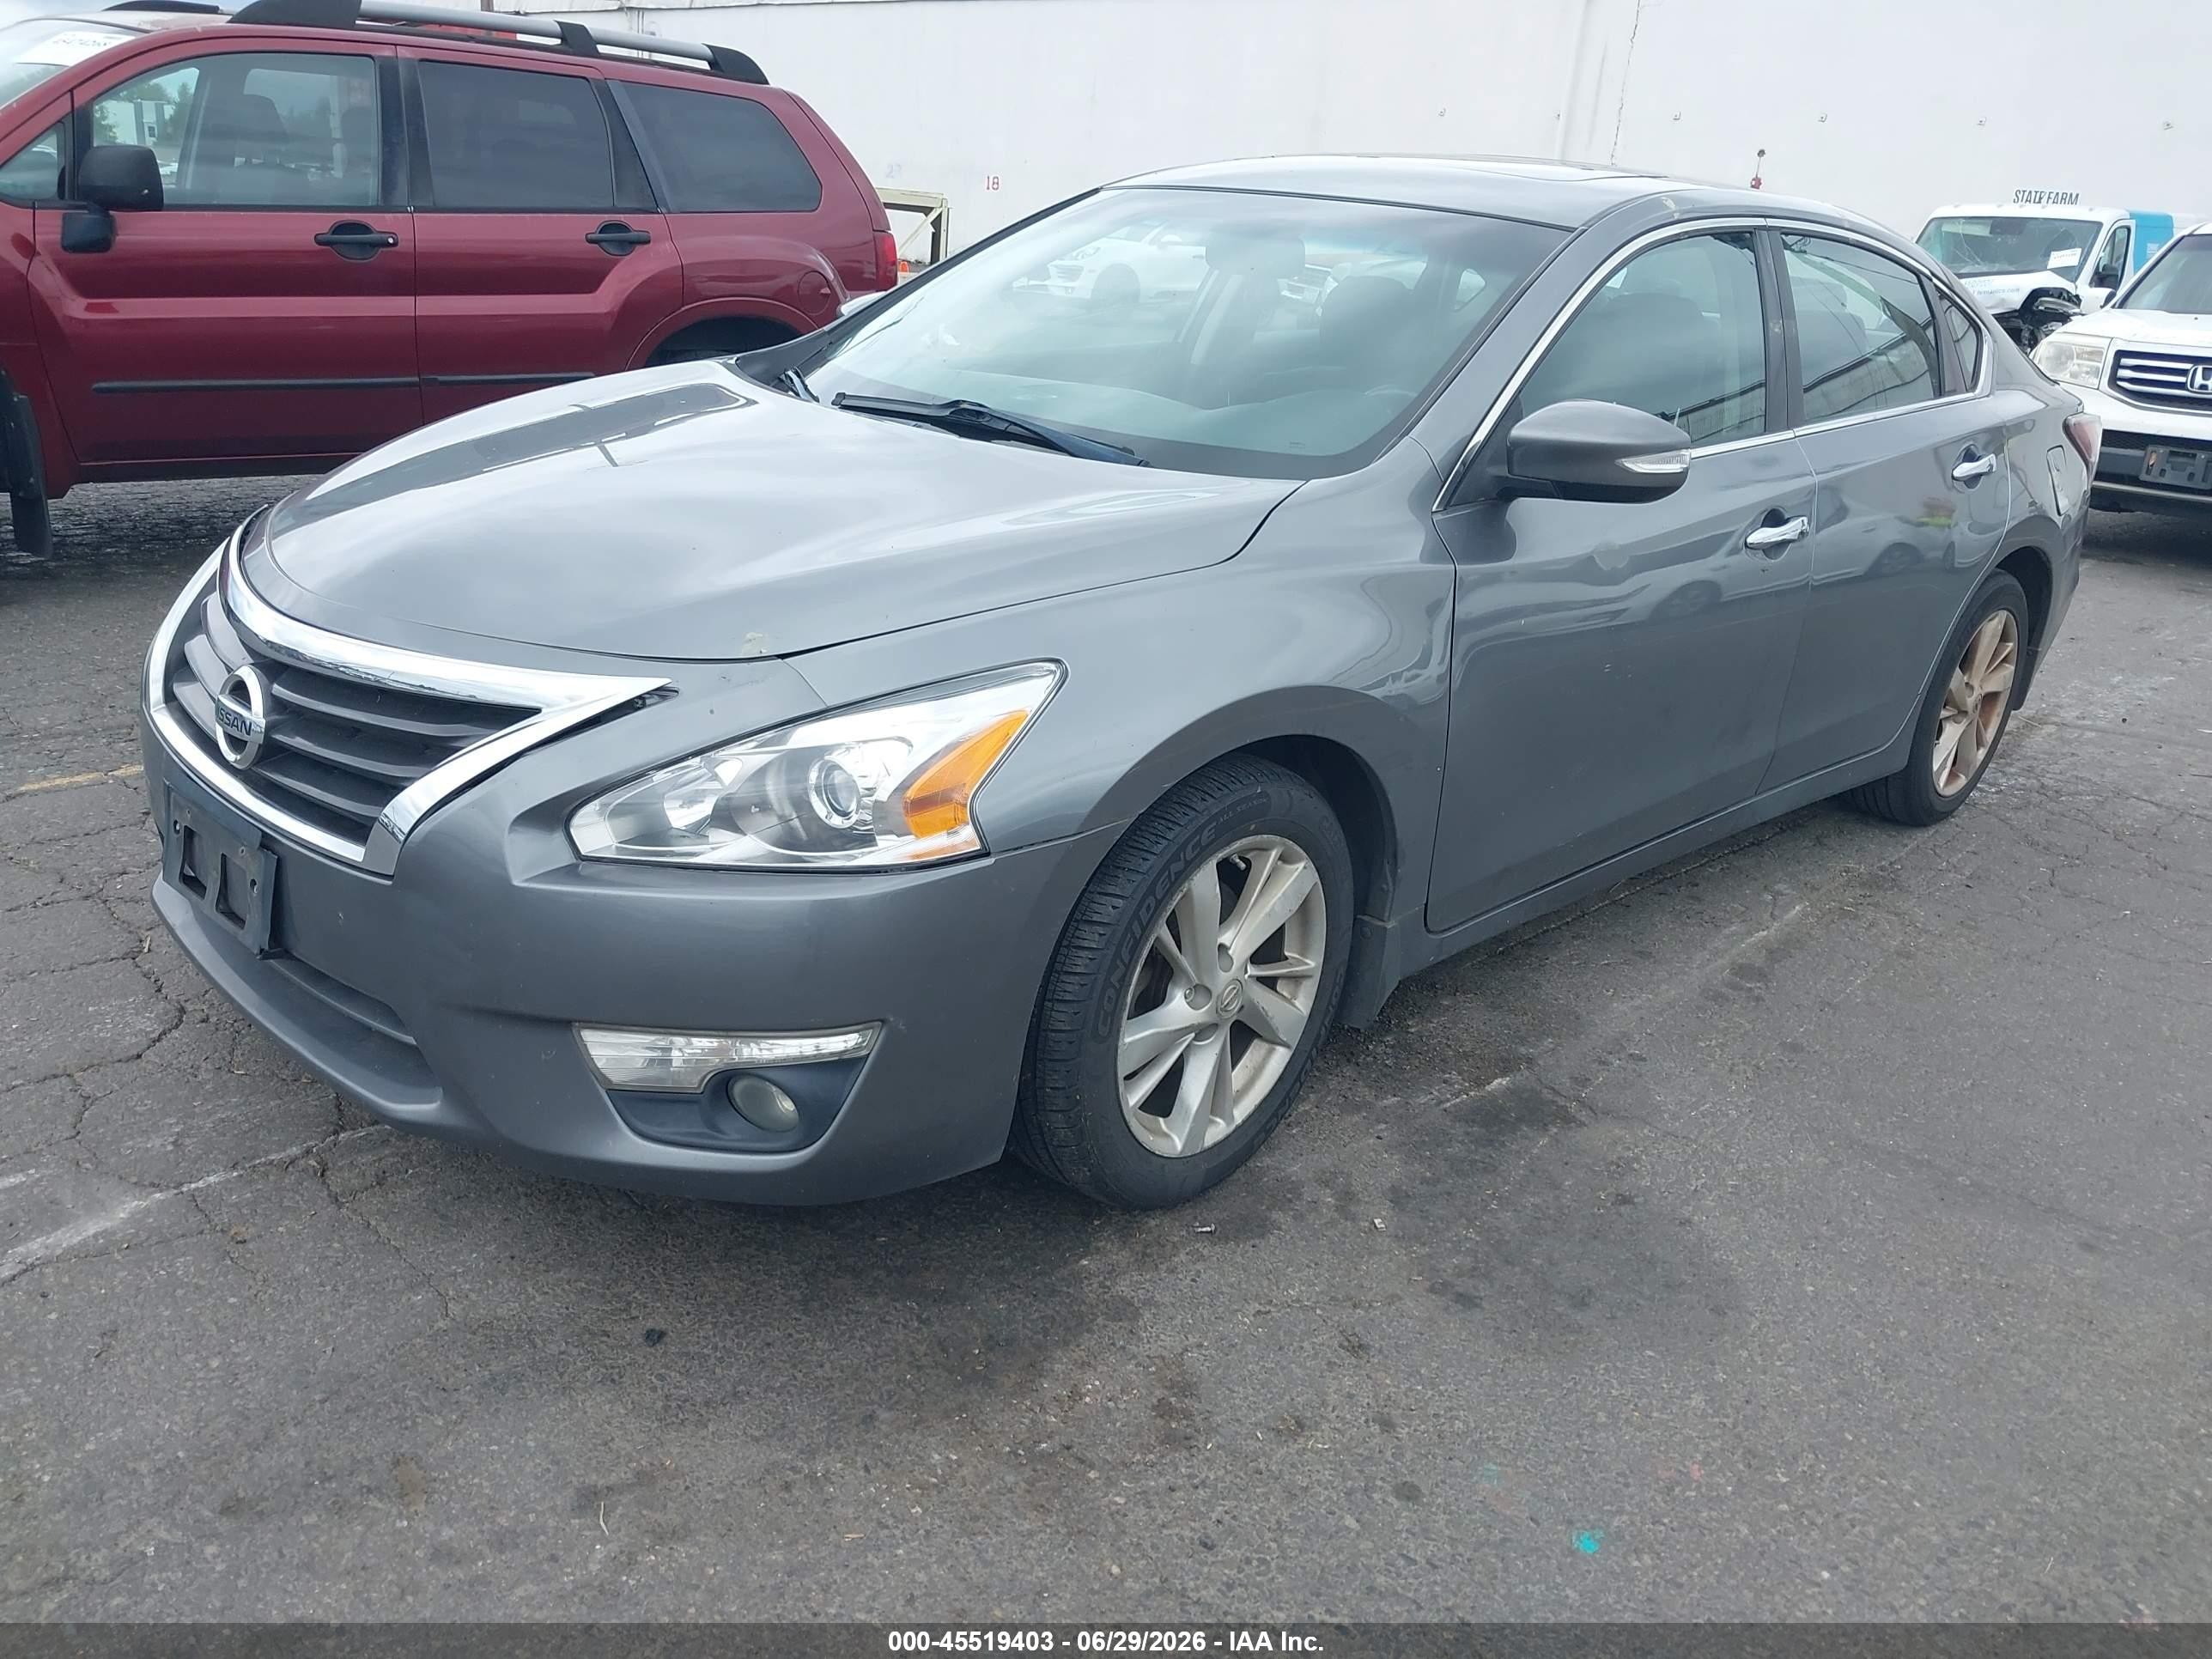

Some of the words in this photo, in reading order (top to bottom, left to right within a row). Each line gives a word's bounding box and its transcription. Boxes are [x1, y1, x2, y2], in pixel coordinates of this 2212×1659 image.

[986, 175, 1000, 191] 18
[2013, 189, 2046, 204] STATE
[2045, 191, 2080, 205] FARM
[1097, 822, 1217, 1036] CONFIDENCE
